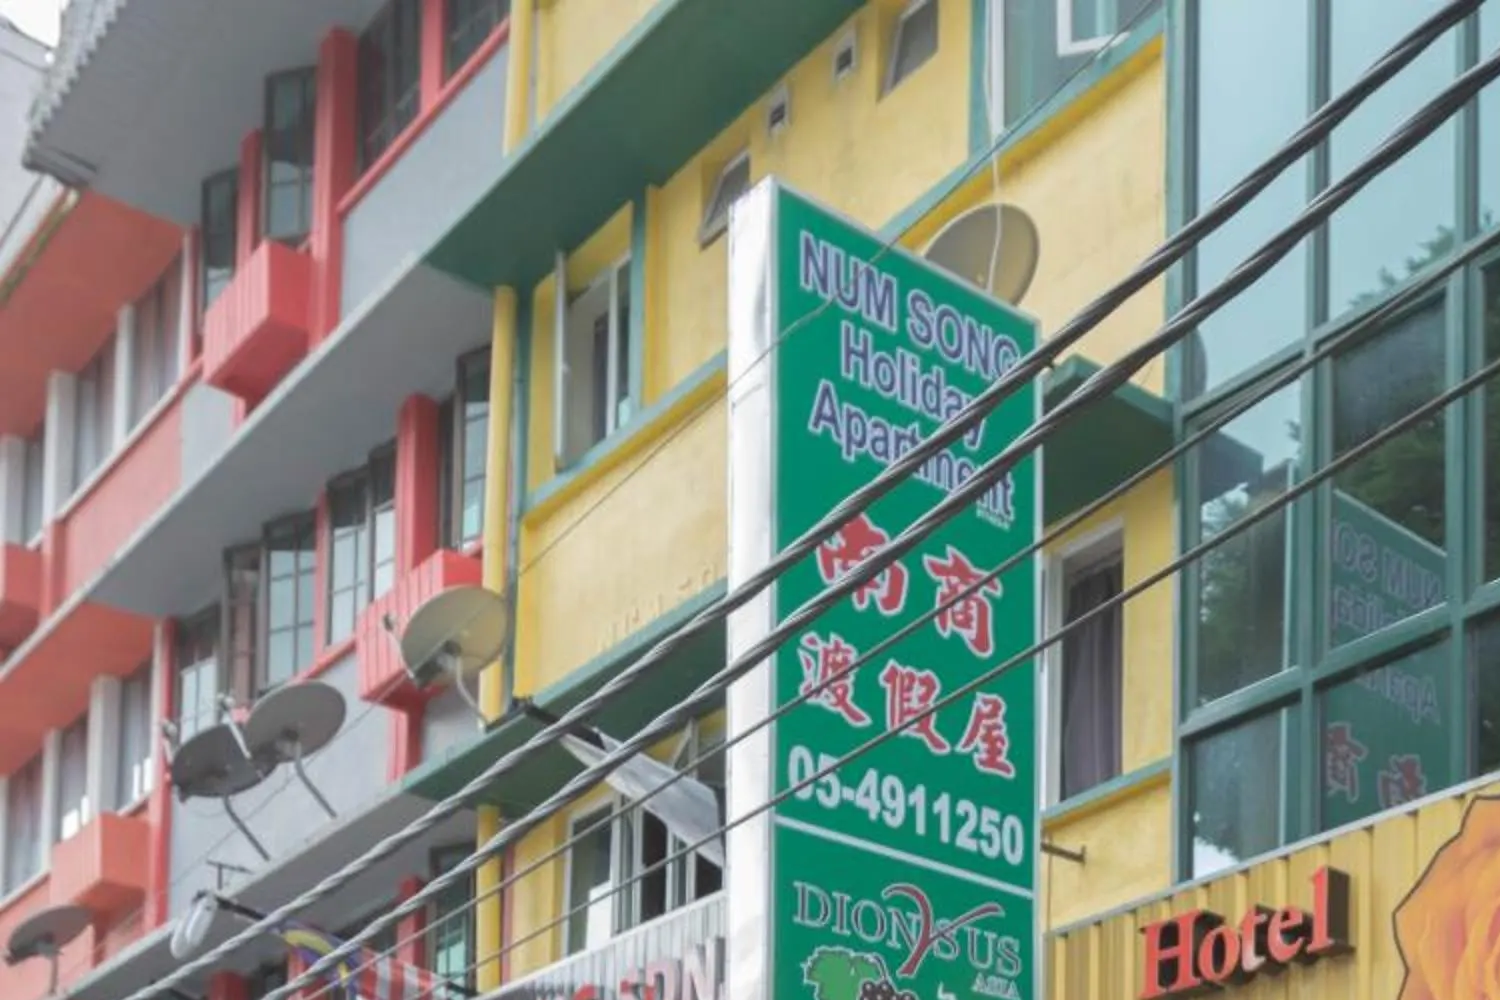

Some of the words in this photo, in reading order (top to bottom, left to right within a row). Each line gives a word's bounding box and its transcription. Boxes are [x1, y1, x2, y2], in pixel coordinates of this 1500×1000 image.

[800, 228, 897, 334] NUM
[906, 287, 1022, 380] SONG
[841, 320, 987, 450] Holiday
[798, 631, 1016, 779] 渡假屋
[788, 745, 1025, 866] 05-4911250
[793, 880, 1022, 979] DIONYSUS
[1138, 866, 1336, 1000] Hotel
